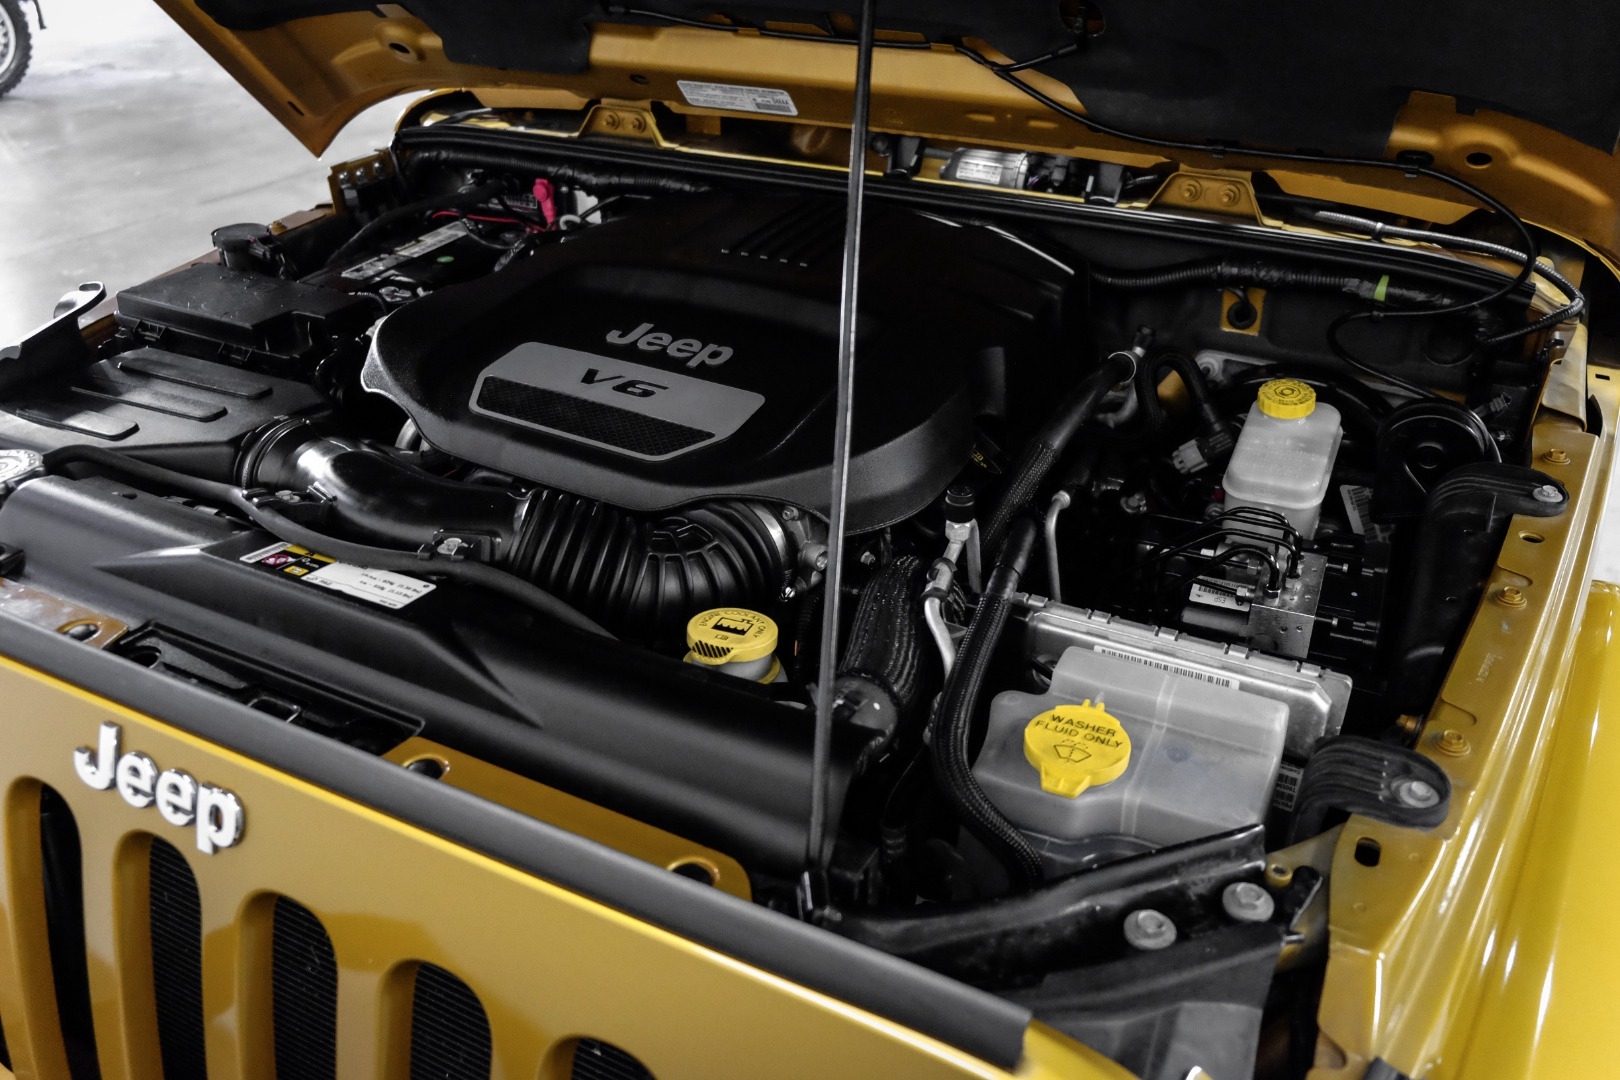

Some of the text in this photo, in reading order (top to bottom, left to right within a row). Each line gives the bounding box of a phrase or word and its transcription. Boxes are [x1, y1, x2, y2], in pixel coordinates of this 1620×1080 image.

[605, 322, 734, 369] Jeep
[579, 367, 669, 400] V6
[698, 610, 767, 639] ENGINE COOLANT ONLY
[1034, 719, 1124, 749] FLUID ONLY
[1051, 714, 1117, 737] WASHER
[73, 721, 246, 856] Jeep
